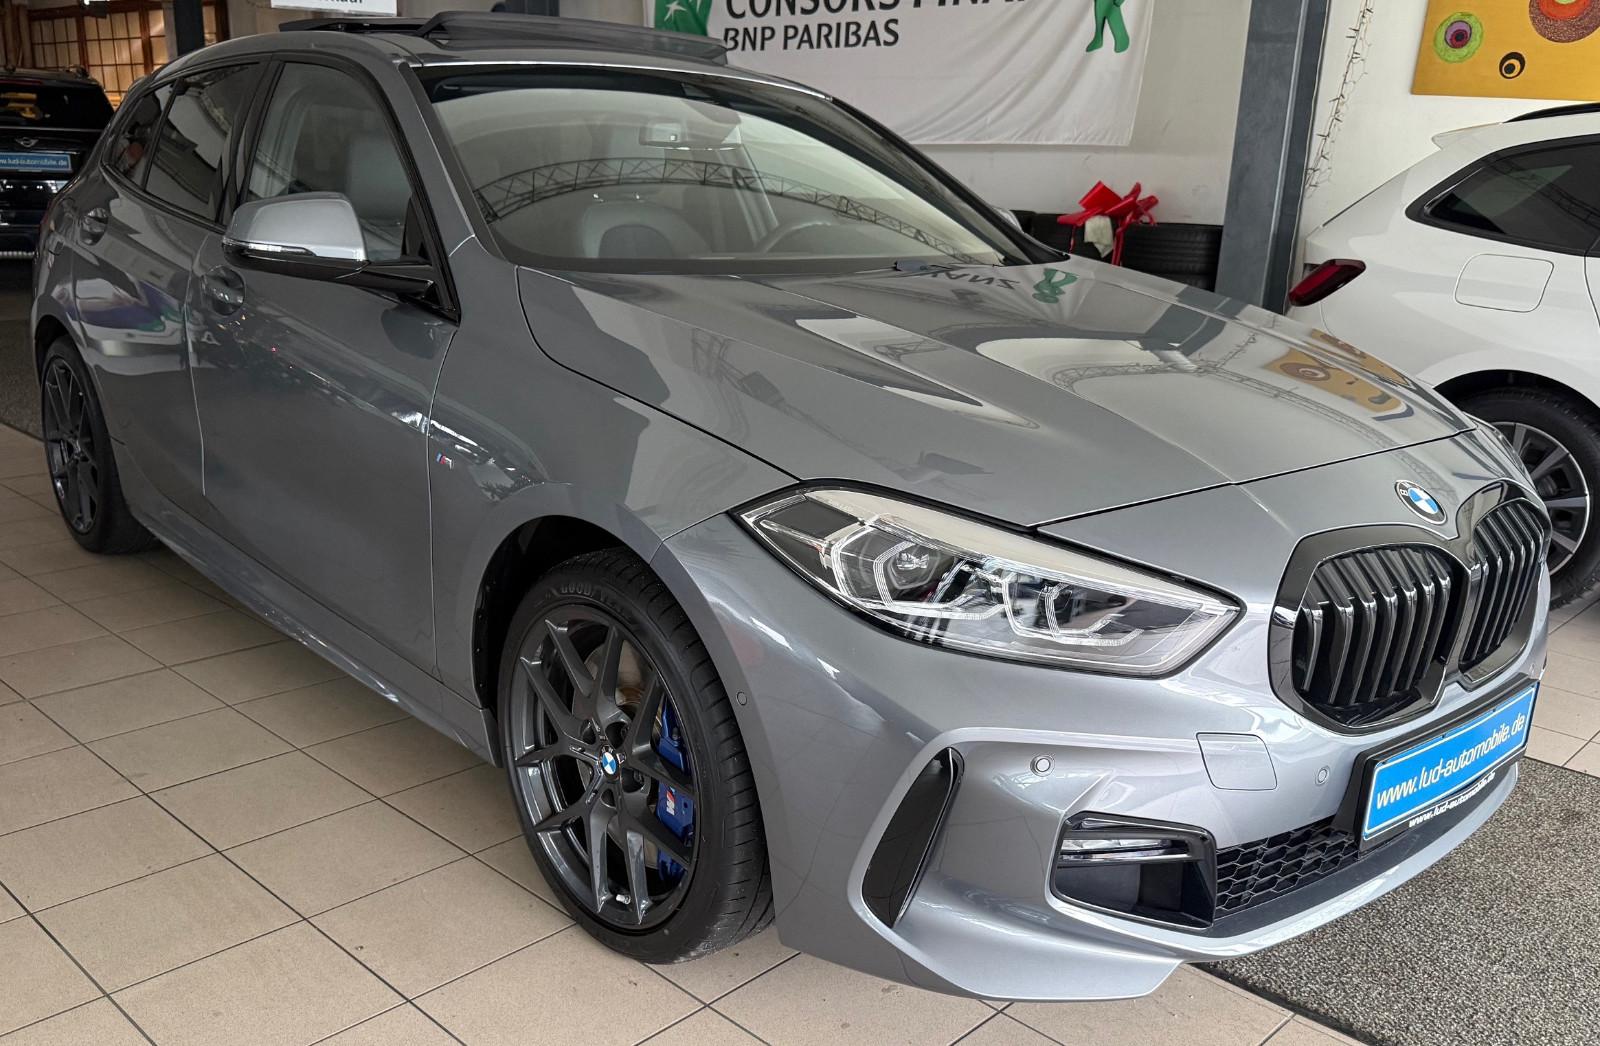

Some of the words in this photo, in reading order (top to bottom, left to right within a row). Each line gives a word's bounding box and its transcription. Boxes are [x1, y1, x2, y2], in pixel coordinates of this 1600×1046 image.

[726, 0, 900, 19] CONS
[724, 27, 775, 51] BNP
[783, 18, 899, 50] PARIBAS
[1377, 713, 1526, 809] www.lud-automobile.de
